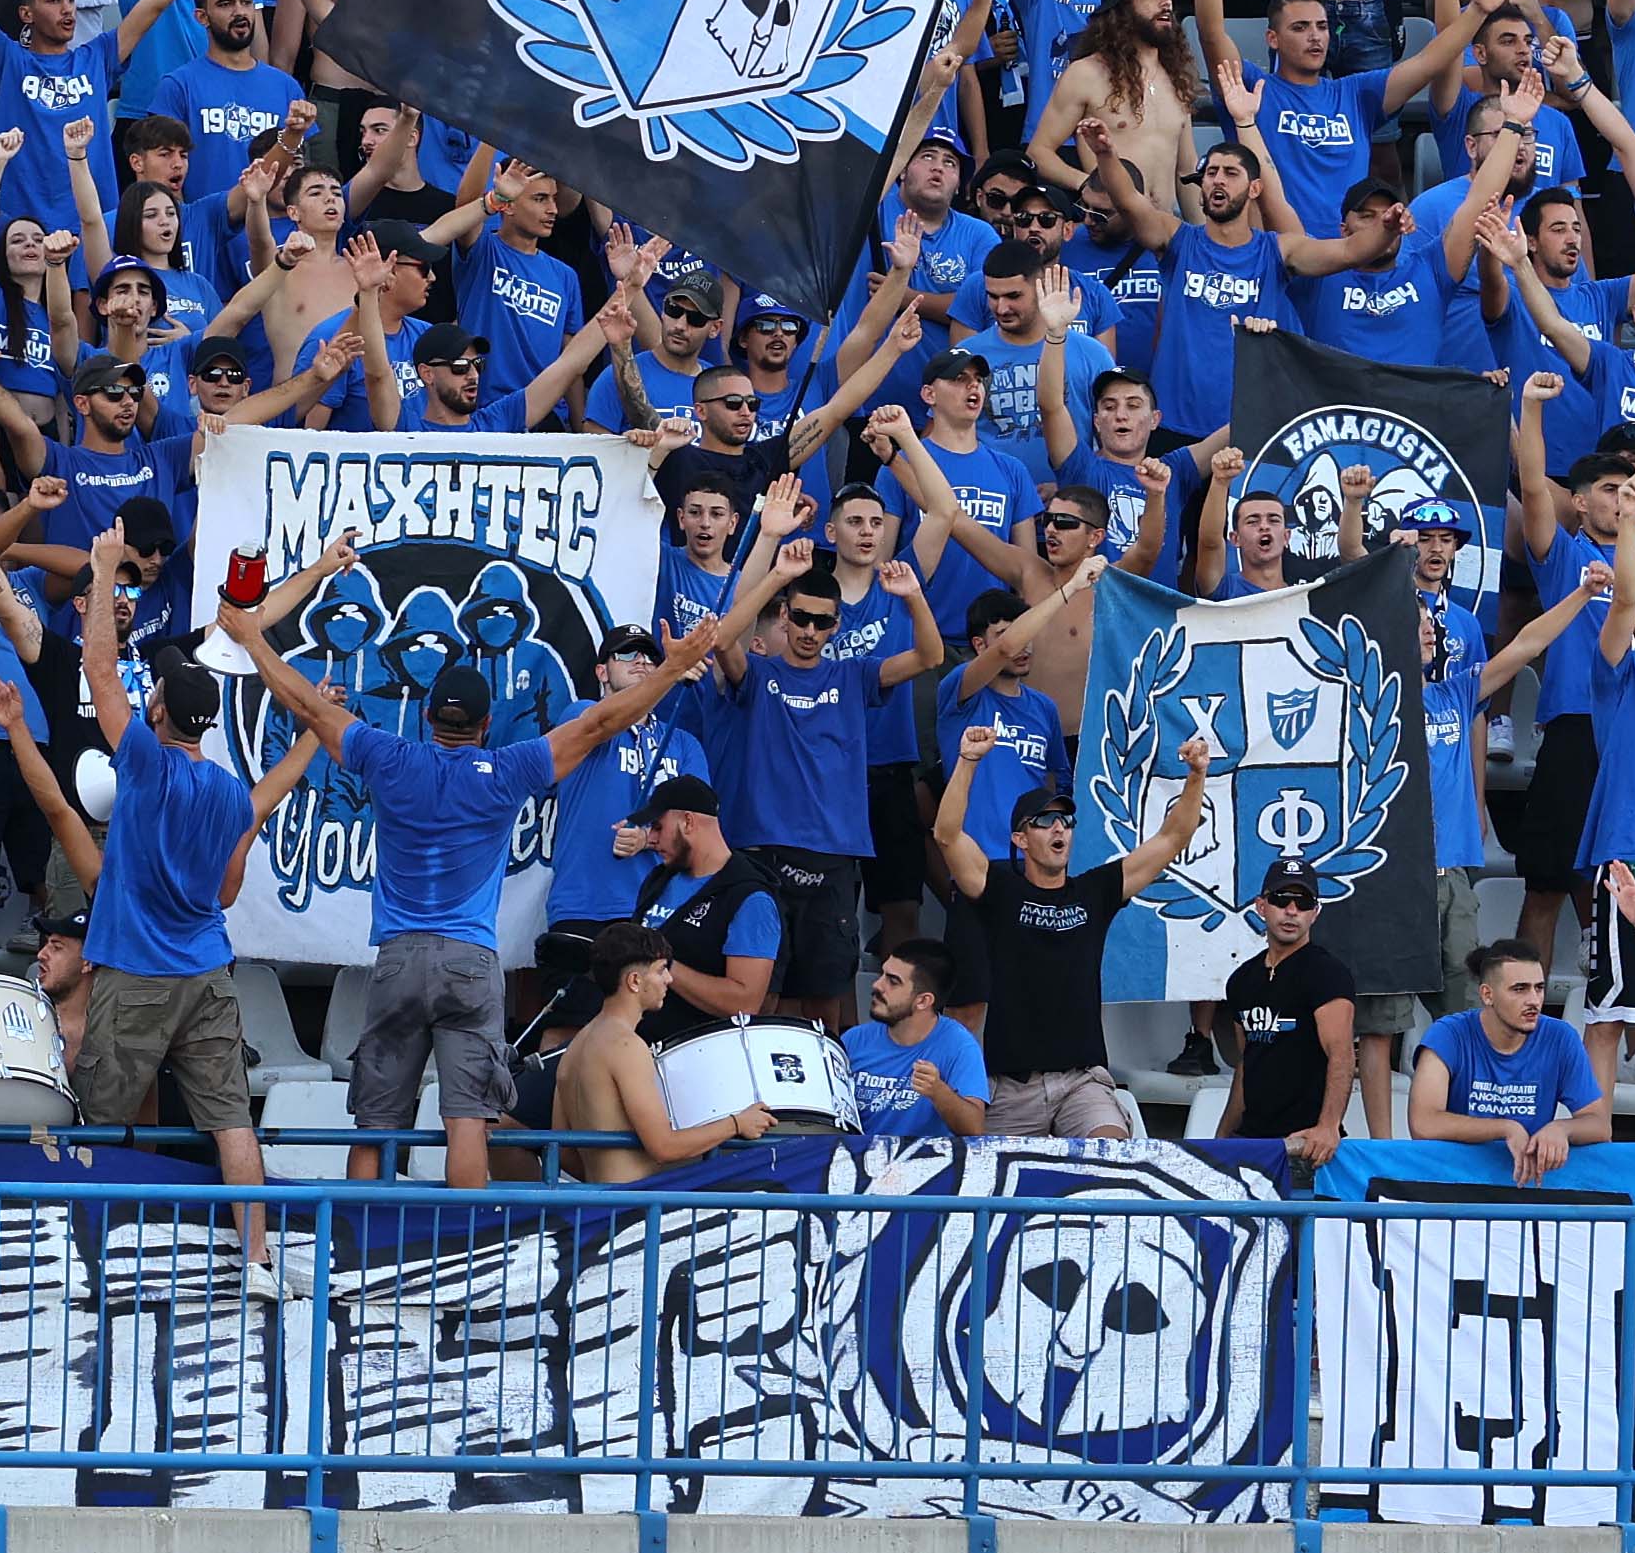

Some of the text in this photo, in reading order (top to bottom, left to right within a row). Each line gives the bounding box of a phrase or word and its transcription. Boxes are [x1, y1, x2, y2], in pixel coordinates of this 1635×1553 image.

[68, 74, 93, 104] 94
[201, 108, 225, 134] 19
[1184, 271, 1259, 304] 19 94
[1343, 282, 1420, 310] 19 94
[1283, 414, 1450, 492] FAMAGUSTA
[619, 747, 638, 774] 19
[1258, 788, 1324, 856] Φ
[857, 1071, 899, 1089] FIGHT
[1478, 1103, 1535, 1116] ΘΑΝΑΤΟΣ
